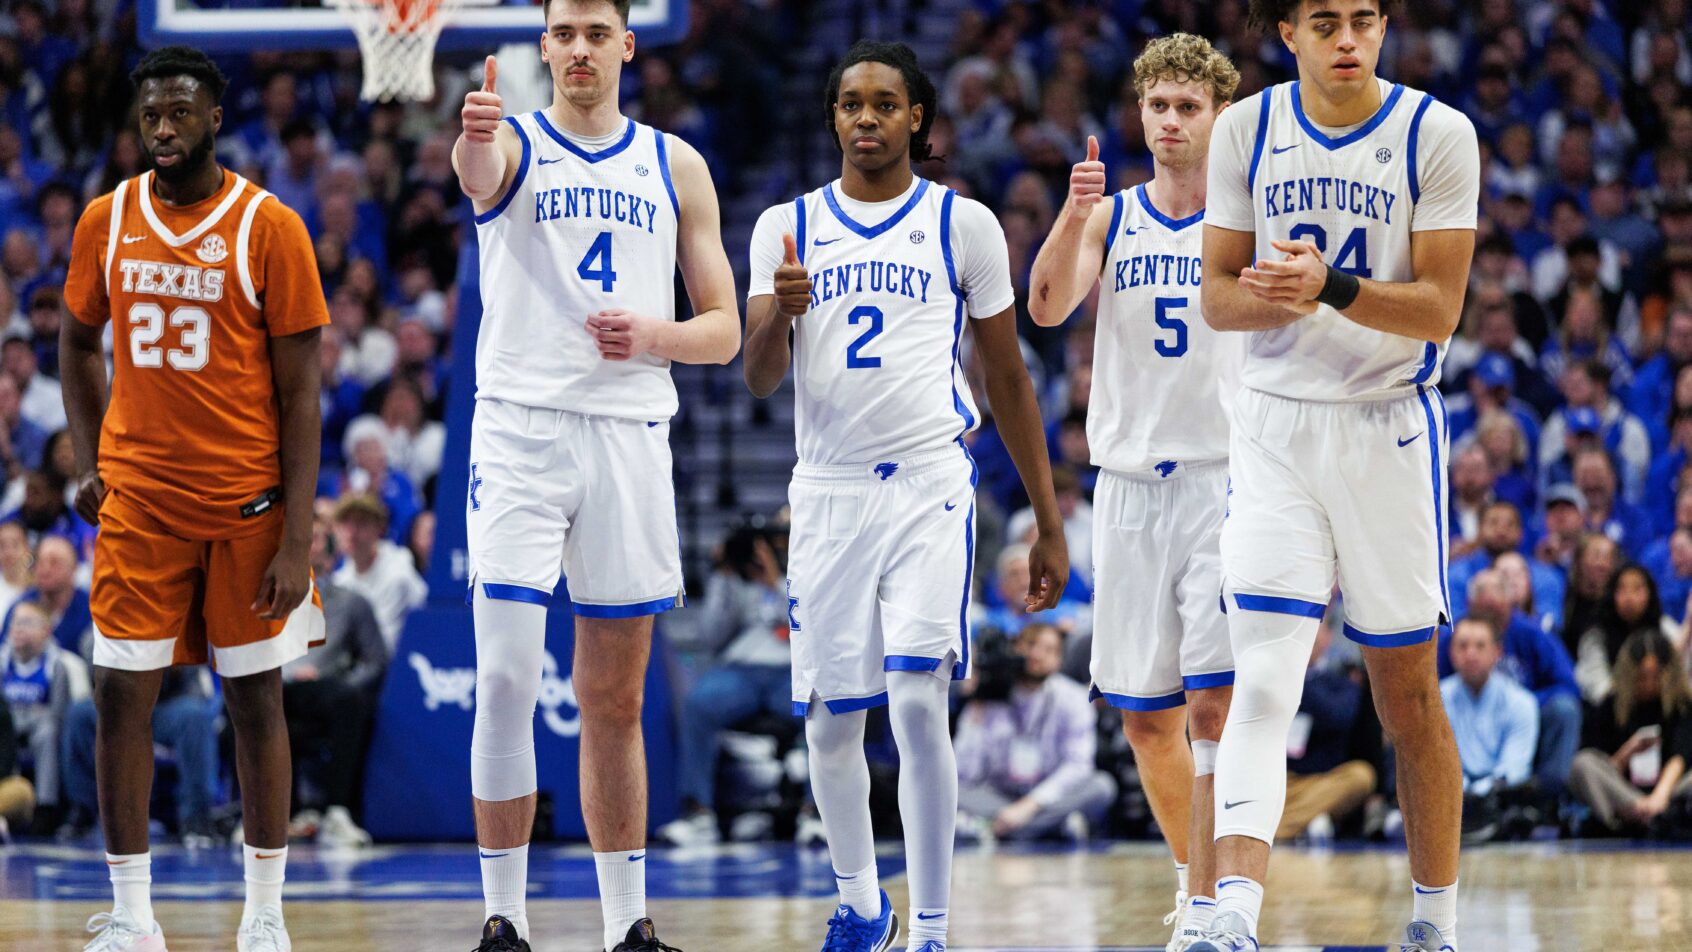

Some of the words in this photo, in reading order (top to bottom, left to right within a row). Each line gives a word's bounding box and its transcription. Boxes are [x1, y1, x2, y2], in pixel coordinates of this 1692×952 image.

[1376, 148, 1392, 163] SEC
[535, 187, 657, 234] KENTUCKY
[1265, 177, 1396, 225] KENTUCKY
[910, 230, 925, 244] SEC
[120, 259, 225, 302] TEXAS
[576, 231, 617, 293] 4
[809, 260, 932, 310] KENTUCKY
[128, 302, 212, 371] 23
[846, 305, 884, 369] 2
[1154, 296, 1188, 358] 5
[1183, 929, 1199, 937] BOOK
